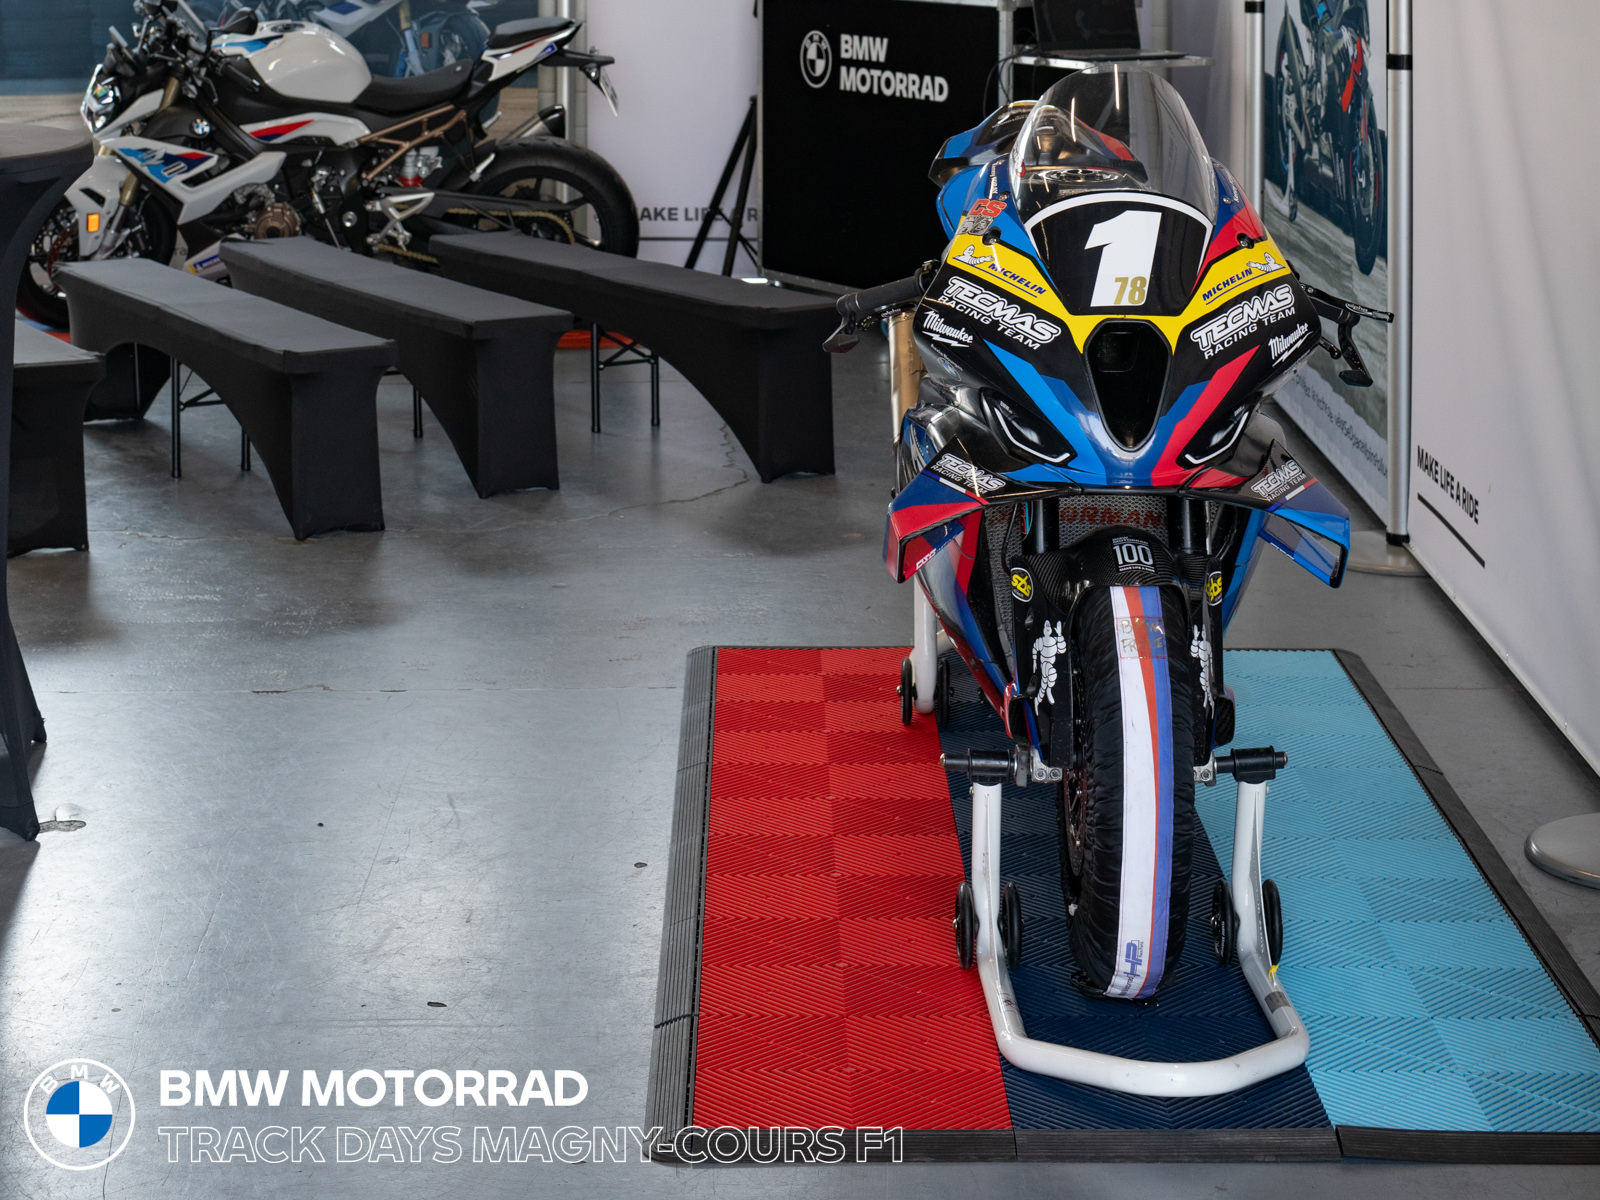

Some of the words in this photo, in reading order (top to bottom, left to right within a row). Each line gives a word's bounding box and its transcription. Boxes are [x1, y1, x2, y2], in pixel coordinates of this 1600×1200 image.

[840, 33, 888, 63] BMW
[839, 66, 949, 103] MOTORRAD
[640, 207, 679, 221] AKE
[1084, 210, 1162, 307] 1
[987, 263, 1047, 296] MICHELIN
[1113, 276, 1147, 305] 78
[1202, 267, 1253, 302] MICHELIN
[923, 310, 974, 344] Milwaukee
[938, 296, 993, 326] RACING
[999, 323, 1041, 350] TEAM
[942, 276, 1062, 344] TECMAS
[1190, 284, 1295, 351] TECMAS
[1204, 323, 1258, 360] RACING
[1262, 307, 1296, 326] TEAM
[1268, 322, 1309, 360] Milwaukee
[931, 464, 963, 482] RACING
[935, 453, 1006, 491] TECMAS
[1251, 460, 1302, 497] TECMAS
[1267, 485, 1290, 502] RACING
[1291, 473, 1307, 486] TEAM
[1417, 445, 1439, 485] MAKE
[1440, 465, 1454, 500] LIFE
[1456, 481, 1461, 506] A
[1462, 486, 1479, 525] RIDE
[1113, 543, 1153, 565] 100
[1011, 573, 1032, 598] sbs
[1123, 942, 1143, 977] HP
